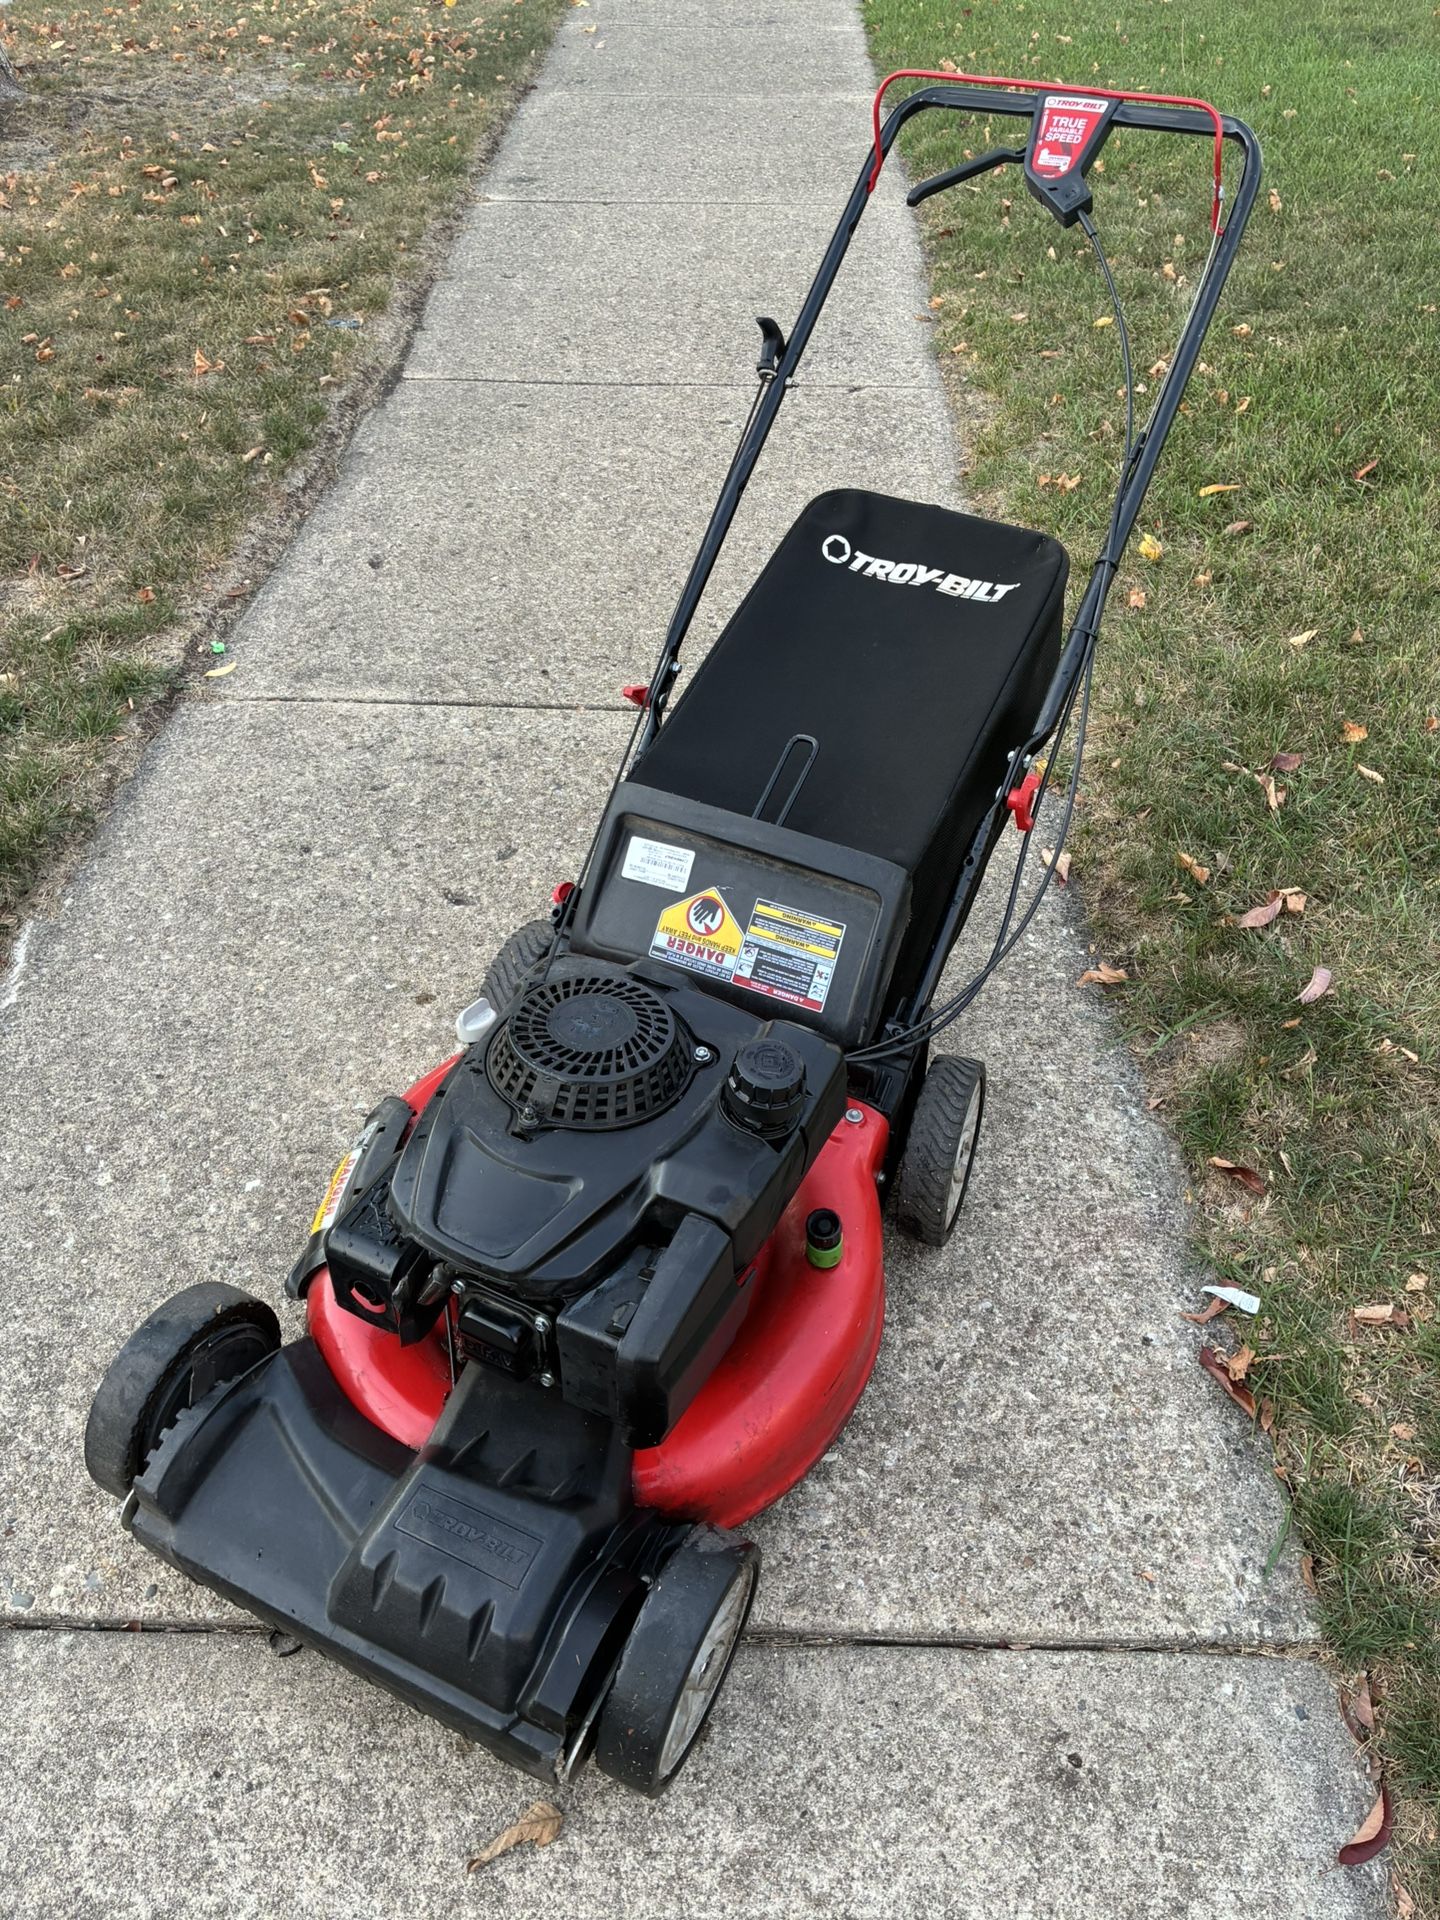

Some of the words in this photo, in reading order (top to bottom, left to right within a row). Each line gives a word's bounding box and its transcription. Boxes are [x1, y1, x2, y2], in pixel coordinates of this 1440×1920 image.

[1056, 99, 1104, 110] TROY-BILT
[1052, 116, 1088, 129] TRUE
[1048, 127, 1085, 136] VARIABLE
[1045, 133, 1082, 144] SPEED
[848, 550, 1021, 603] TROY-BILT
[780, 912, 812, 925] WARNING
[661, 924, 678, 935] AWAY
[677, 929, 691, 940] FEET
[690, 934, 702, 943] and
[701, 937, 721, 949] HANDS
[774, 933, 804, 947] WARNING
[665, 935, 726, 965] DANGER
[719, 943, 736, 954] KEEP
[772, 987, 799, 1001] DANGER
[325, 1158, 356, 1216] DANGER
[427, 1508, 530, 1564] TROY-BILT
